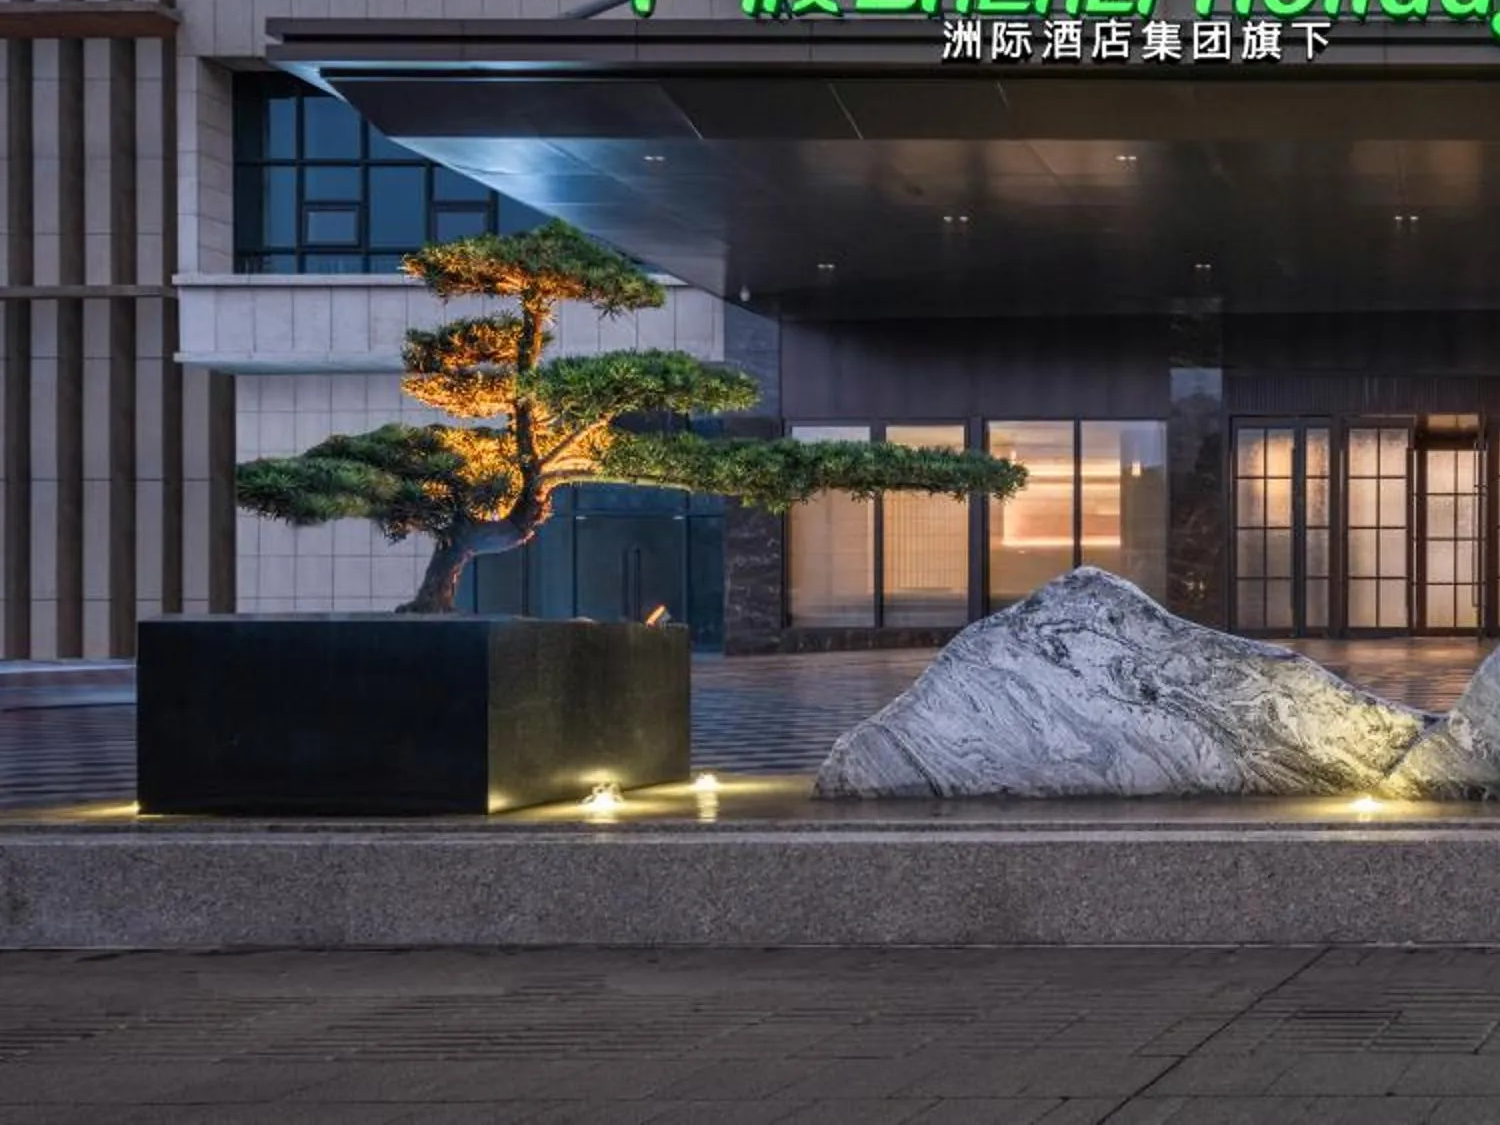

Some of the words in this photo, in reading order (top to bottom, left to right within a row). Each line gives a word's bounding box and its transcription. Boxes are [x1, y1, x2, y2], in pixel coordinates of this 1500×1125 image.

[942, 18, 1332, 60] 洲际酒店集团旗下
